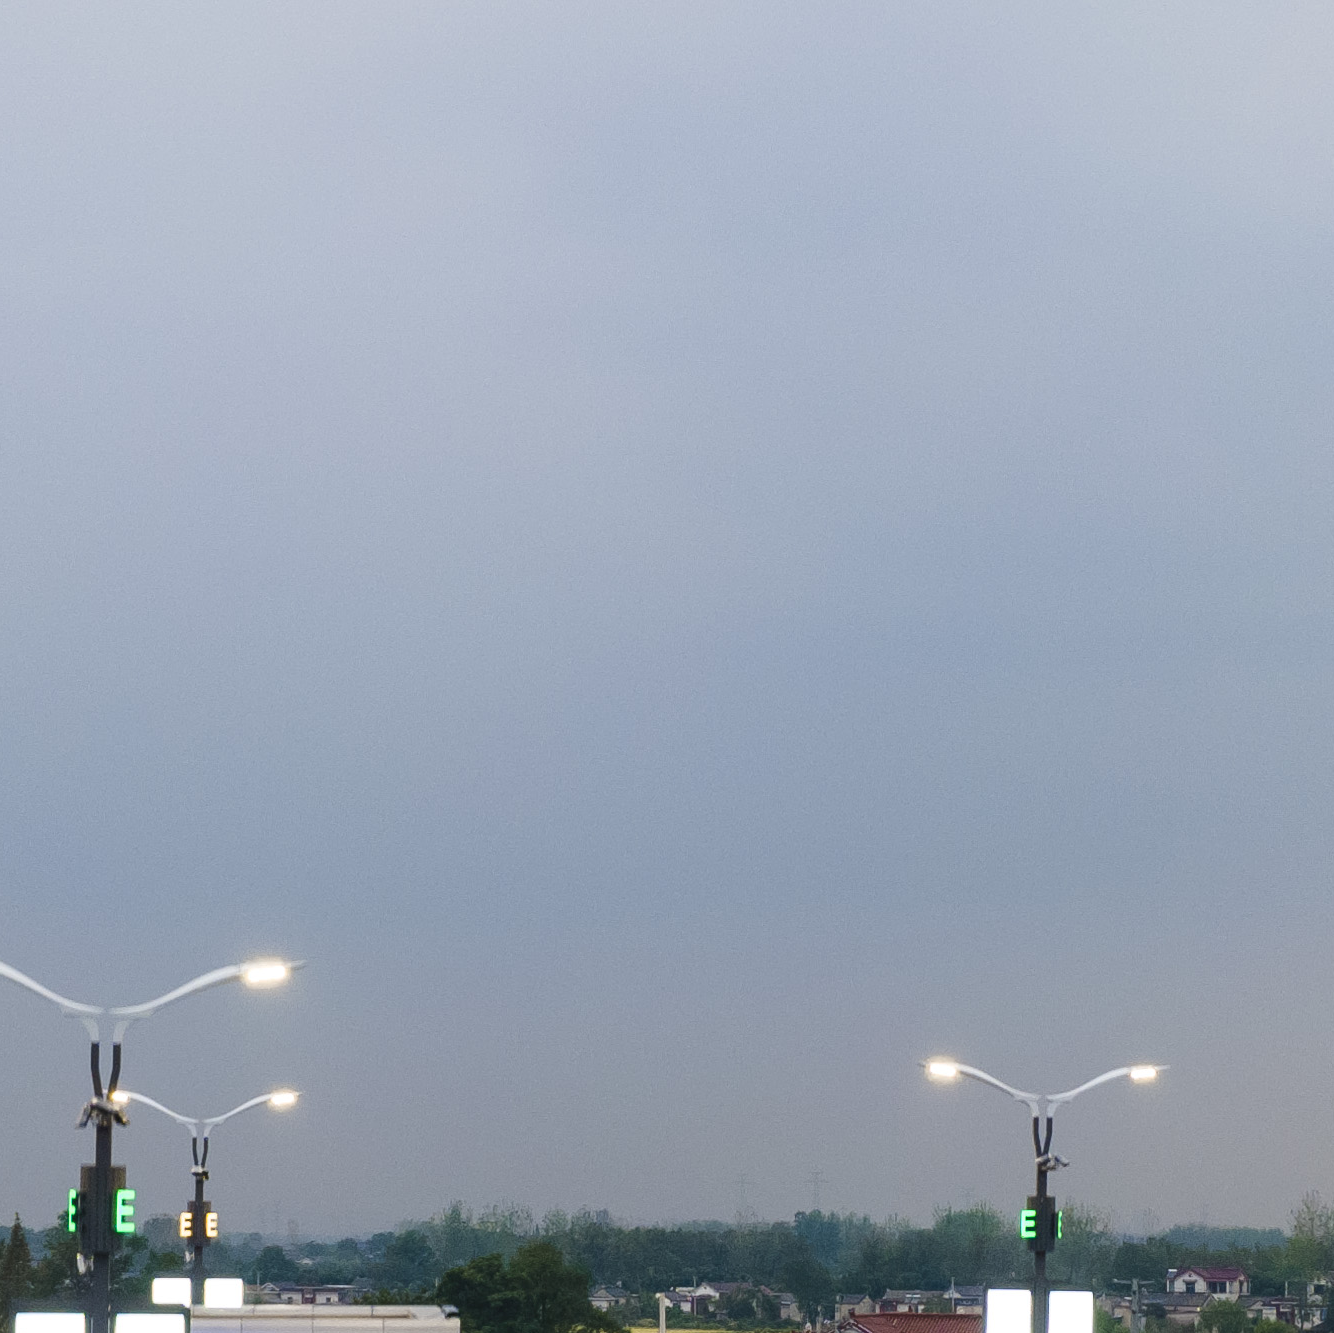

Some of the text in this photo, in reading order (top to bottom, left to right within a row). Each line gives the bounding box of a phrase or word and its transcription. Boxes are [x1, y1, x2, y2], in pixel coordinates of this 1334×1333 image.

[116, 1188, 136, 1233] E
[179, 1211, 193, 1238] E
[205, 1211, 219, 1238] E
[1020, 1209, 1037, 1239] E
